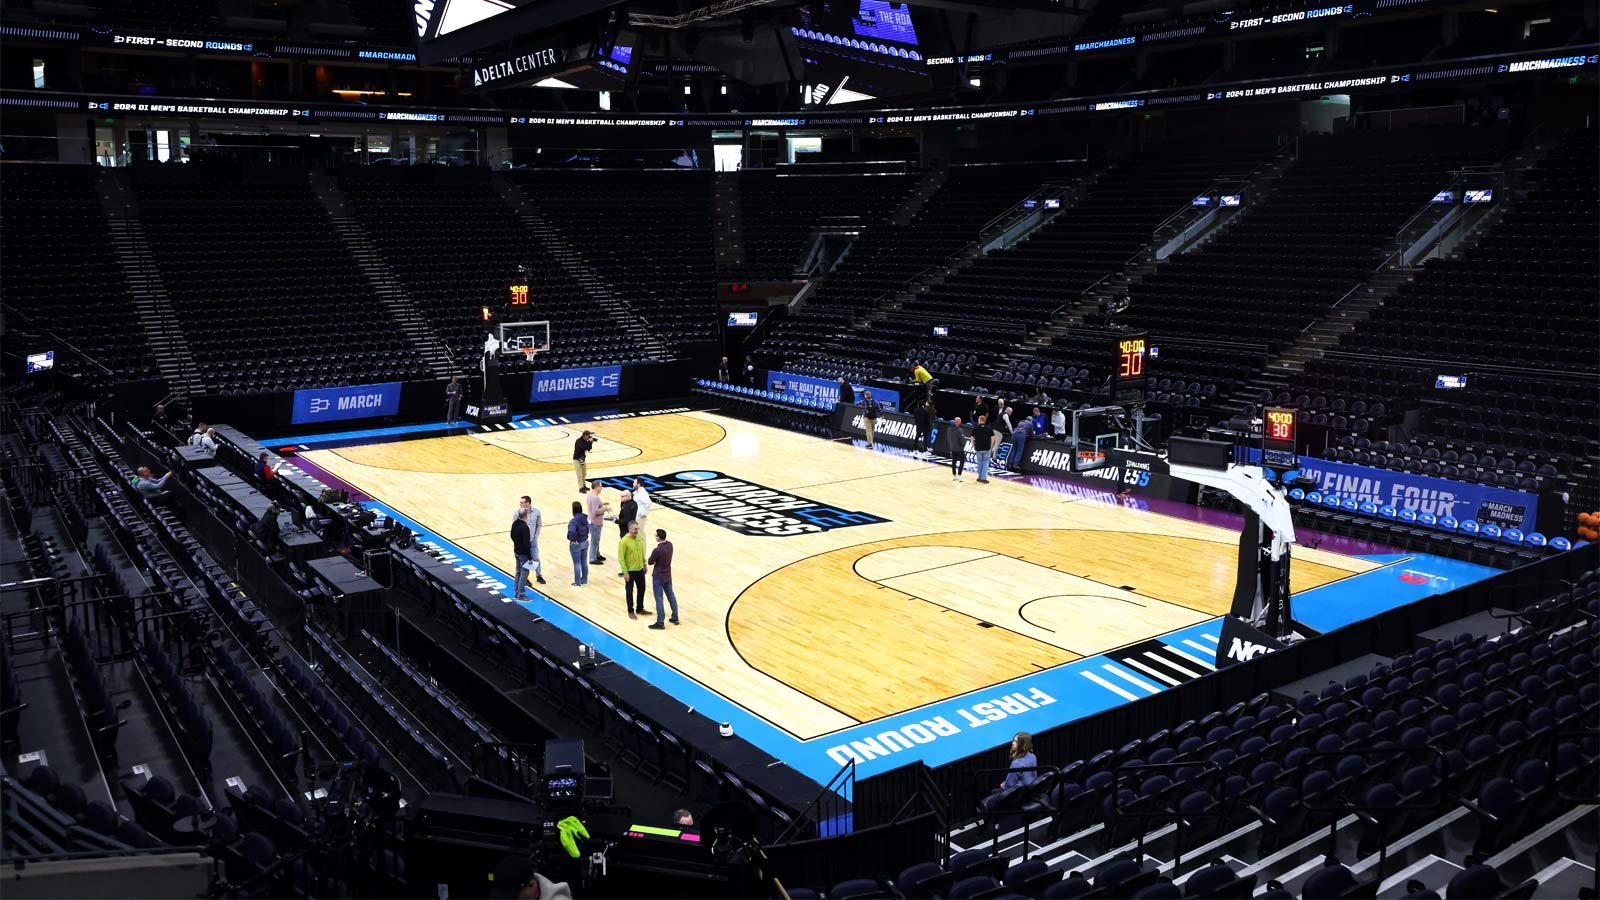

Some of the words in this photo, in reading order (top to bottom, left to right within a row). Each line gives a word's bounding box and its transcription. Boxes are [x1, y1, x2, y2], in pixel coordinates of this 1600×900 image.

[1239, 17, 1264, 28] FIRST
[1272, 12, 1305, 24] SECOND
[1306, 6, 1343, 18] ROUNDS
[125, 36, 155, 45] FIRST
[166, 39, 203, 48] SECOND
[205, 42, 243, 51] ROUNDS
[1074, 37, 1136, 51] #MARCHMADNESS
[482, 61, 515, 83] DELTA
[515, 48, 556, 73] CENTER
[927, 57, 954, 65] SECOND
[1508, 56, 1586, 72] MARCHMADNESS
[1226, 90, 1244, 98] 2024
[1277, 83, 1322, 94] BASKETBALL
[1324, 76, 1387, 90] CHAMPIONSHIP
[113, 103, 137, 111] 2024
[177, 106, 226, 114] BASKETBALL
[228, 108, 288, 116] CHAMPIONSHIP
[387, 113, 437, 121] MARCHMADNESS
[932, 113, 970, 121] BASKETBALL
[971, 110, 1018, 119] CHAMPIONSHIP
[512, 292, 527, 304] 30
[1120, 340, 1144, 353] 40:00
[1120, 353, 1142, 376] 30
[537, 376, 595, 392] MADNESS
[789, 381, 799, 391] THE
[799, 383, 813, 393] ROAD
[338, 394, 382, 410] MARCH
[1268, 412, 1292, 424] 40:00
[1273, 424, 1288, 438] 30
[687, 478, 820, 511] MARCH
[1323, 471, 1383, 505] FINAL
[1390, 483, 1455, 516] FOUR
[653, 487, 823, 535] MADNESS
[1488, 502, 1513, 513] MARCH
[1490, 510, 1524, 523] MADNESS
[956, 687, 1058, 728] FIRST
[825, 716, 962, 767] ROUND
